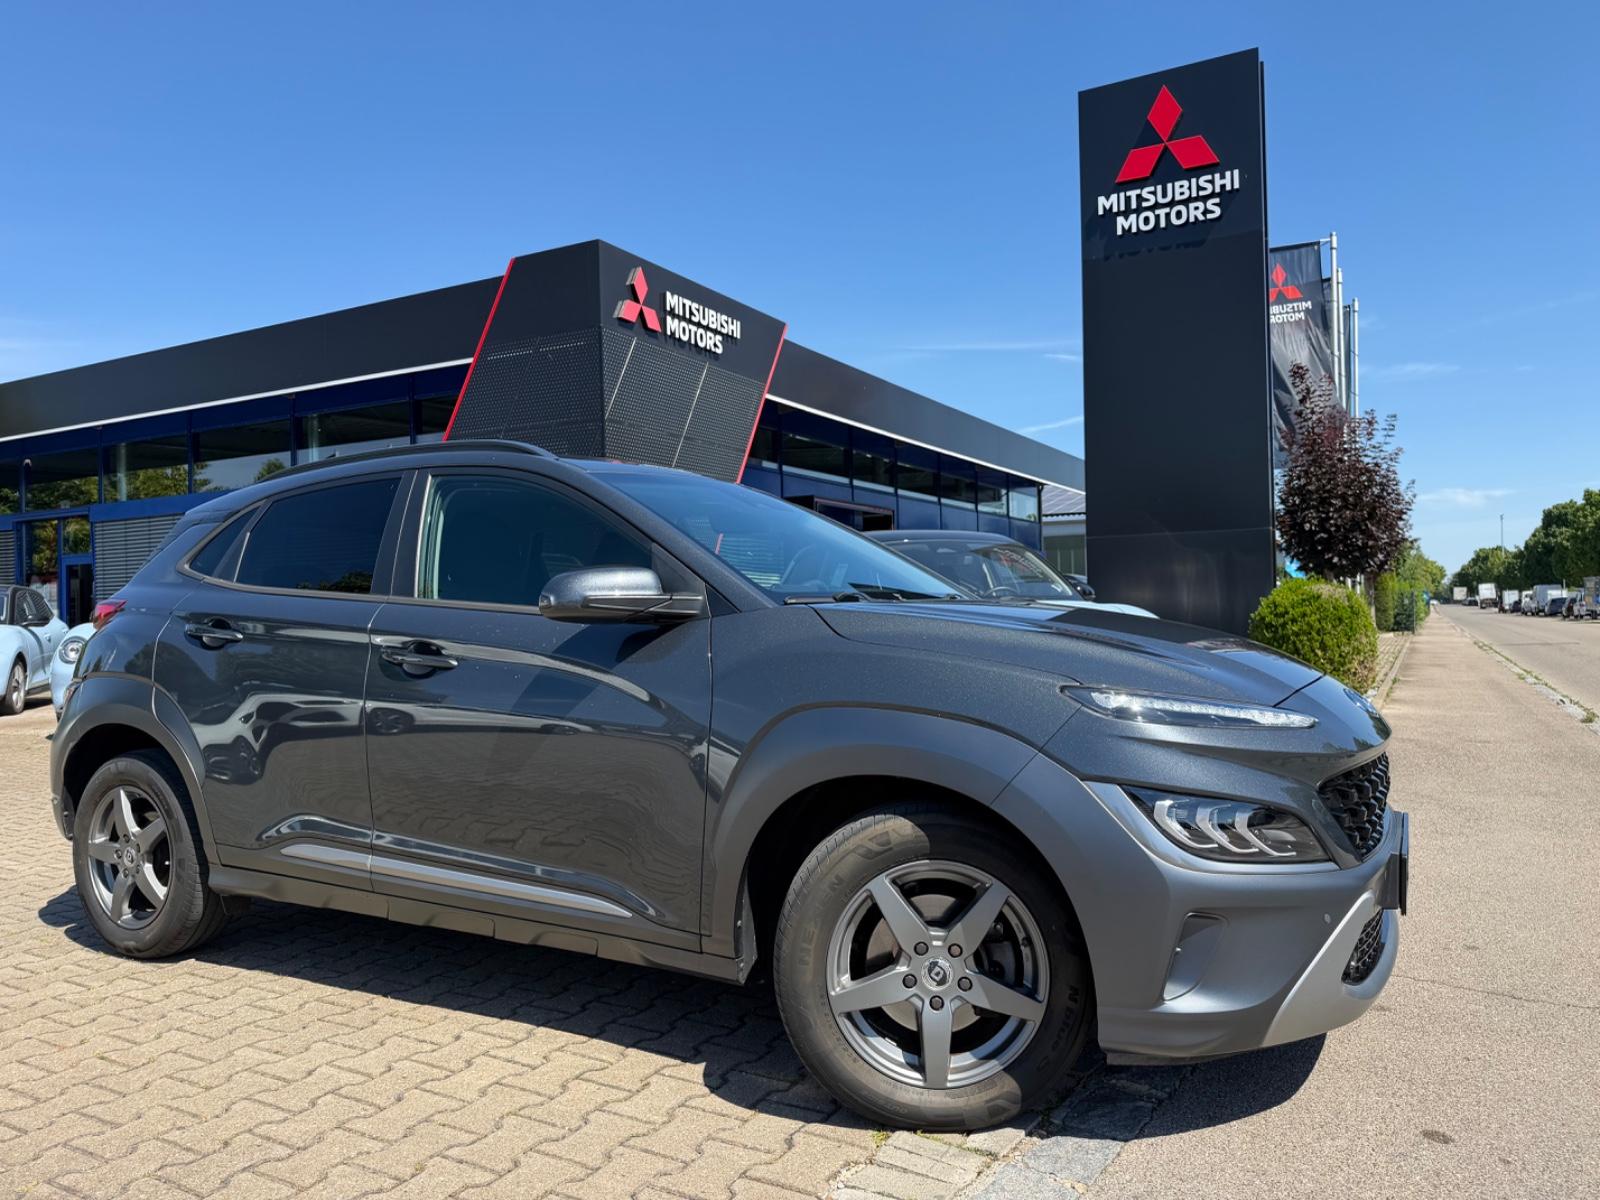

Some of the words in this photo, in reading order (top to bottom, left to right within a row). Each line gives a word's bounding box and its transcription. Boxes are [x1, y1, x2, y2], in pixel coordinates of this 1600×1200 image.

[1097, 168, 1240, 216] MITSUBISHI
[1117, 198, 1222, 236] MOTORS
[665, 290, 742, 340] MITSUBISHI
[665, 314, 724, 355] MOTORS
